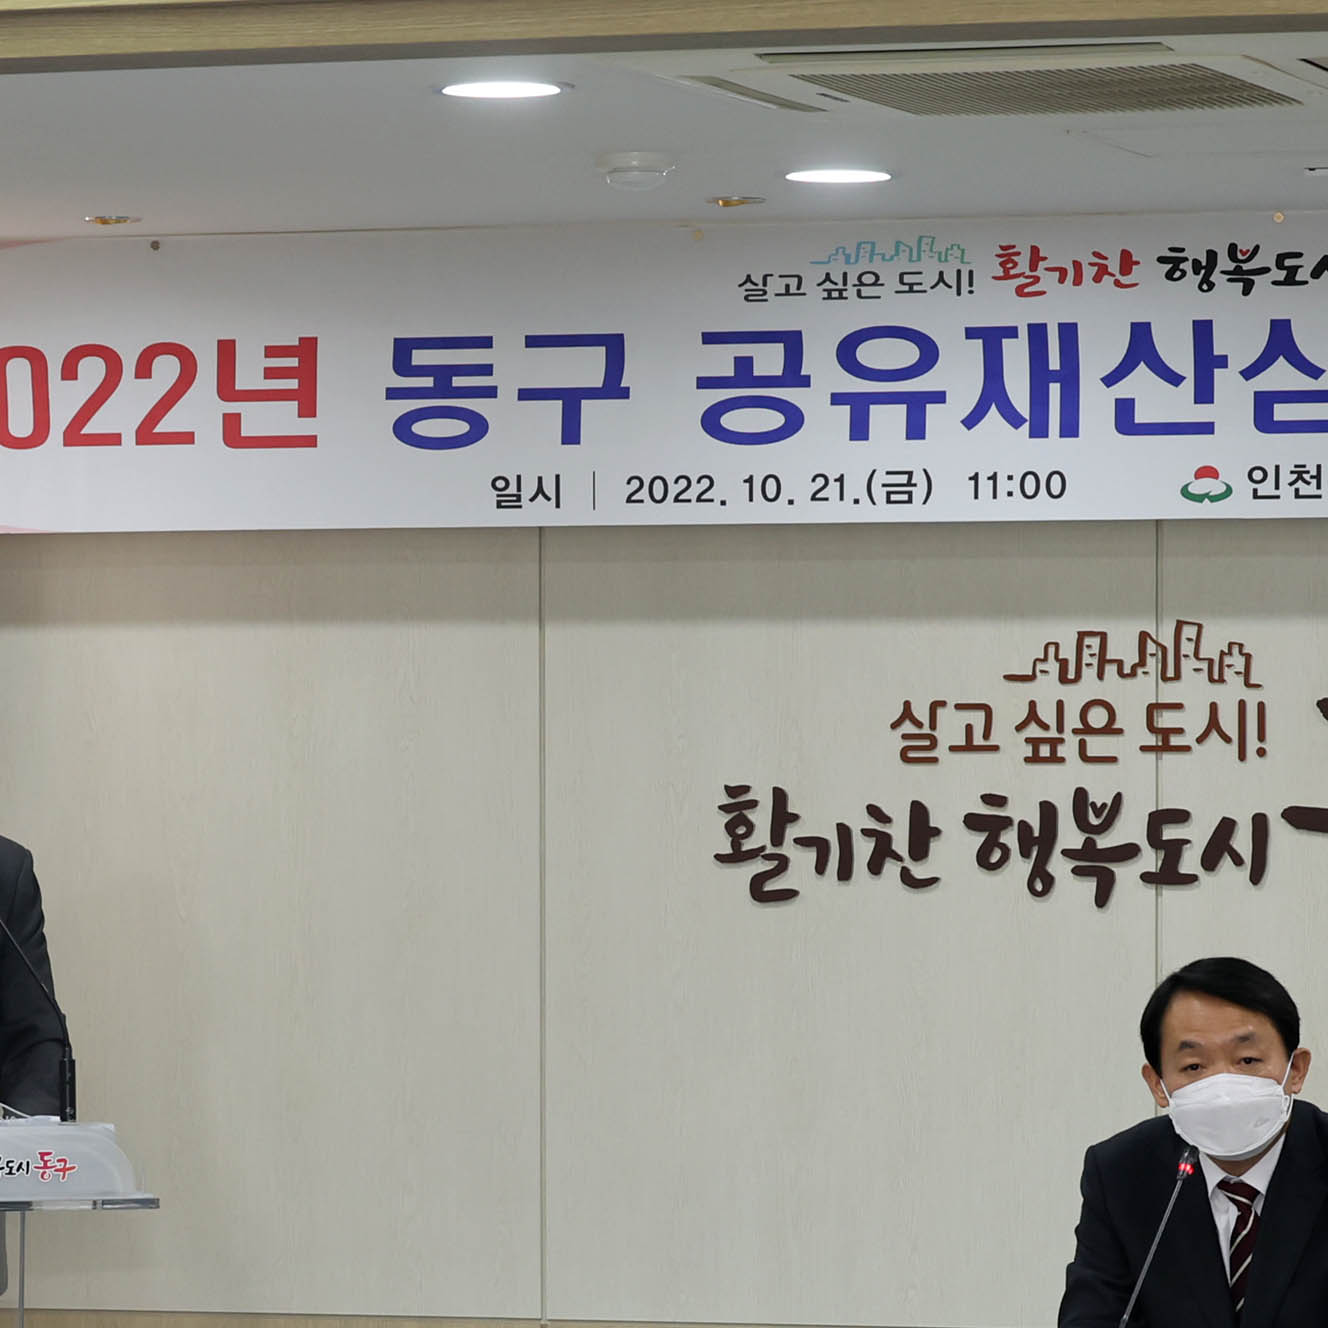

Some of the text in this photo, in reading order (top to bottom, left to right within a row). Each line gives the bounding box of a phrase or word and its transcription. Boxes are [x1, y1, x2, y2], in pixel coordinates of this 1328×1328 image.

[737, 273, 807, 303] 살고
[816, 270, 886, 301] 싶은
[894, 266, 975, 298] 도시!
[991, 243, 1141, 298] 활기찬
[384, 332, 631, 451] 동구
[490, 473, 561, 510] 일시
[967, 469, 1067, 501] 11:00
[888, 698, 1268, 766] 살고 싶은 도시!
[712, 783, 943, 905] 활기찬
[962, 785, 1271, 909] 행복도시
[33, 1150, 77, 1182] 동구
